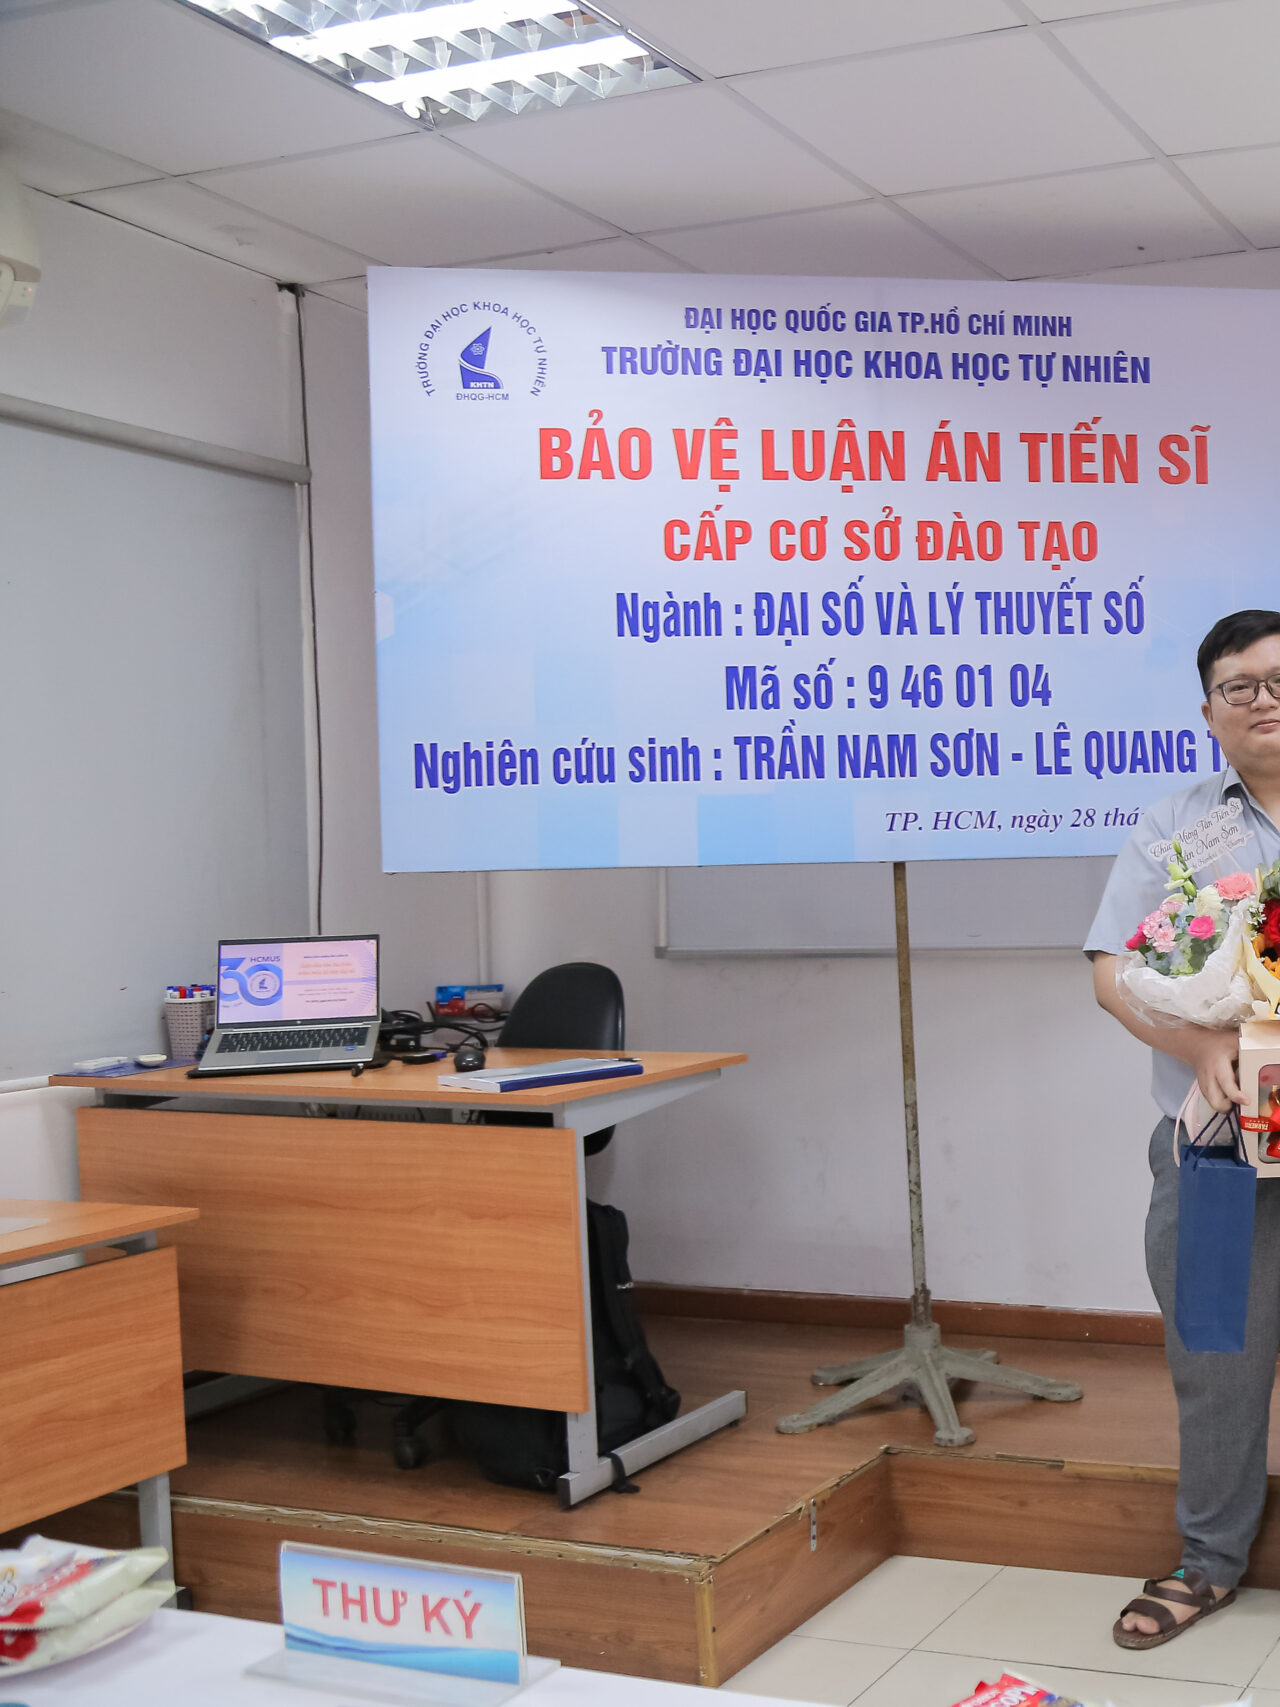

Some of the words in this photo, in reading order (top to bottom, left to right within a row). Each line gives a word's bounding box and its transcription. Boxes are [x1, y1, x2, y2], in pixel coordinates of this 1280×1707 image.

[442, 303, 469, 322] HỌC
[473, 301, 509, 316] KHOA
[511, 312, 537, 335] HỌC
[685, 307, 723, 334] ĐẠI
[731, 308, 777, 335] HỌC
[785, 302, 846, 332] QUỐC
[854, 311, 892, 333] GIA
[898, 306, 960, 335] TP.HỒ
[968, 310, 1005, 336] CHÍ
[1013, 316, 1073, 337] MINH
[424, 319, 443, 339] ĐẠI
[533, 336, 548, 354] TỰ
[415, 342, 436, 397] TRƯỜNG
[530, 357, 548, 397] NHIÊN
[601, 340, 723, 376] TRƯỜNG
[733, 349, 782, 383] ĐẠI
[794, 349, 853, 384] HỌC
[864, 350, 943, 380] KHOA
[952, 352, 1010, 387] HỌC
[1018, 352, 1057, 388] TỰ
[1063, 350, 1151, 384] NHIÊN
[456, 393, 509, 401] ĐHQG-HCM
[469, 381, 495, 389] KHTN
[538, 409, 653, 481] BẢO
[672, 417, 740, 493] VỆ
[761, 418, 905, 493] LUẬN
[926, 420, 1000, 482] ÁN
[1019, 416, 1139, 484] TIẾN
[1158, 424, 1211, 485] SĨ
[664, 504, 752, 562] CẤP
[769, 515, 828, 562] CƠ
[843, 505, 902, 562] SỞ
[915, 511, 1003, 562] ĐÀO
[1017, 520, 1098, 571] TẠO
[616, 591, 722, 643] Ngành
[754, 591, 809, 647] ĐẠI
[821, 575, 865, 637] SỐ
[875, 582, 917, 636] VÀ
[928, 582, 962, 636] LÝ
[975, 577, 1093, 636] THUYẾT
[1103, 576, 1145, 635] SỐ
[724, 665, 780, 711] Mã
[793, 657, 836, 711] số
[868, 664, 889, 709] 9
[901, 664, 944, 708] 46
[955, 664, 993, 708] 01
[1009, 663, 1052, 707] 04
[413, 739, 539, 794] Nghiên
[552, 737, 616, 785] cứu
[628, 736, 700, 784] sinh
[733, 719, 825, 782] TRẦN
[837, 733, 917, 780] NAM
[929, 728, 999, 777] SƠN
[1035, 721, 1073, 776] LÊ
[1084, 729, 1197, 781] QUANG
[885, 811, 923, 832] TP.
[931, 810, 1002, 832] HCM,
[1010, 808, 1063, 833] ngày
[1070, 808, 1097, 828] 28
[1103, 807, 1145, 827] thá
[1196, 834, 1220, 855] Nam
[312, 1578, 408, 1627] THƯ
[422, 1590, 483, 1640] KÝ
